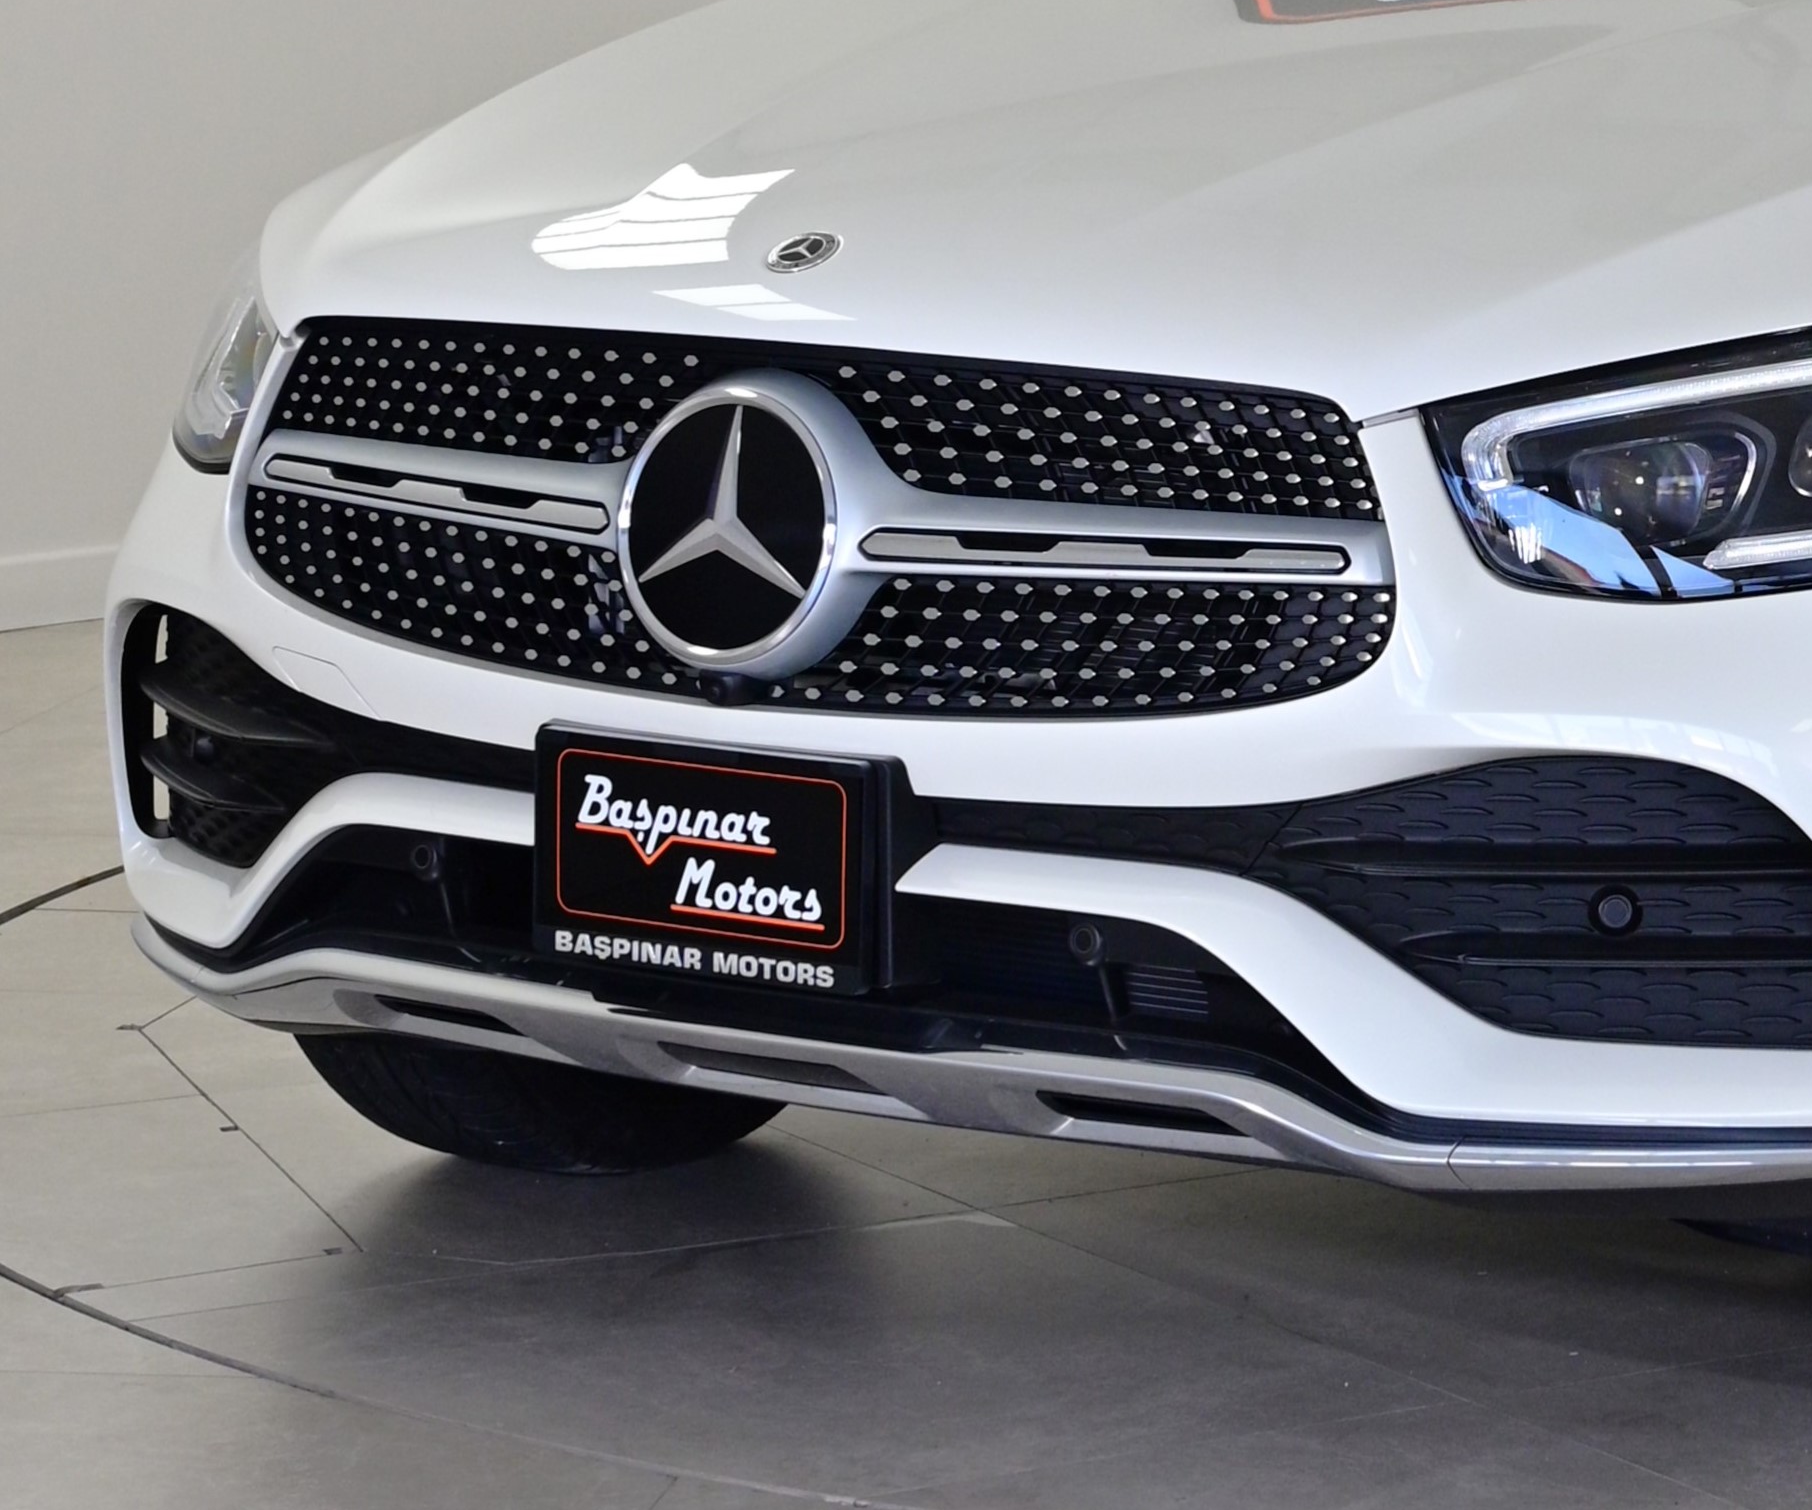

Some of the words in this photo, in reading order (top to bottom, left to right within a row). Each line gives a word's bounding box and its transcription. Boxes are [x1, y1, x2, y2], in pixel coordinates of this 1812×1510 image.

[674, 856, 823, 922] Motors
[554, 930, 702, 971] BAŞPINAR
[712, 951, 835, 988] MOTORS
